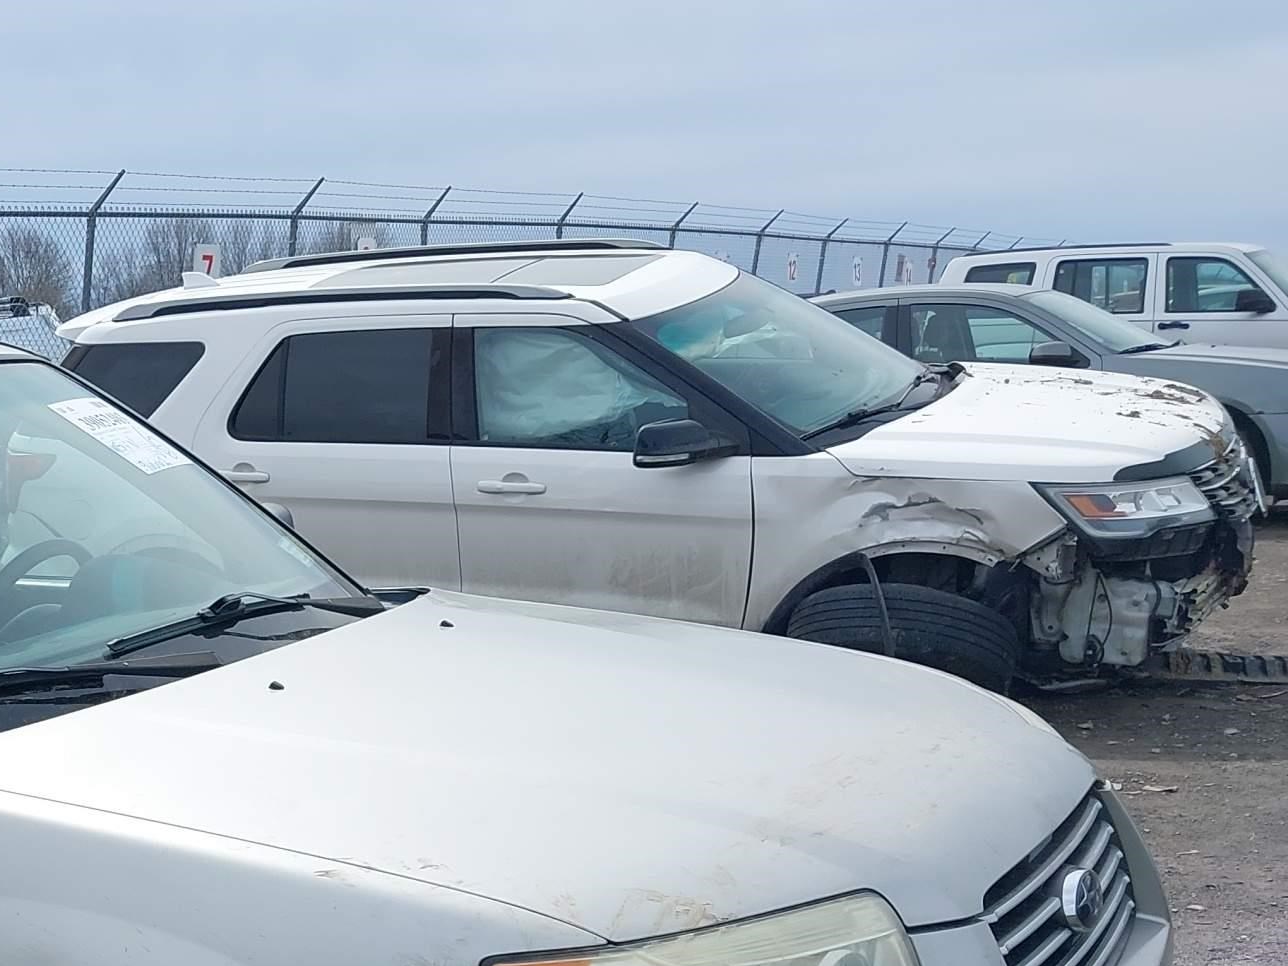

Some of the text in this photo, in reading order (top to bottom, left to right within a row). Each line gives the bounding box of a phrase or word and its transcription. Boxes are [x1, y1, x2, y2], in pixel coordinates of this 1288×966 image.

[202, 254, 213, 275] 7
[788, 260, 797, 281] 12
[853, 264, 861, 283] 13
